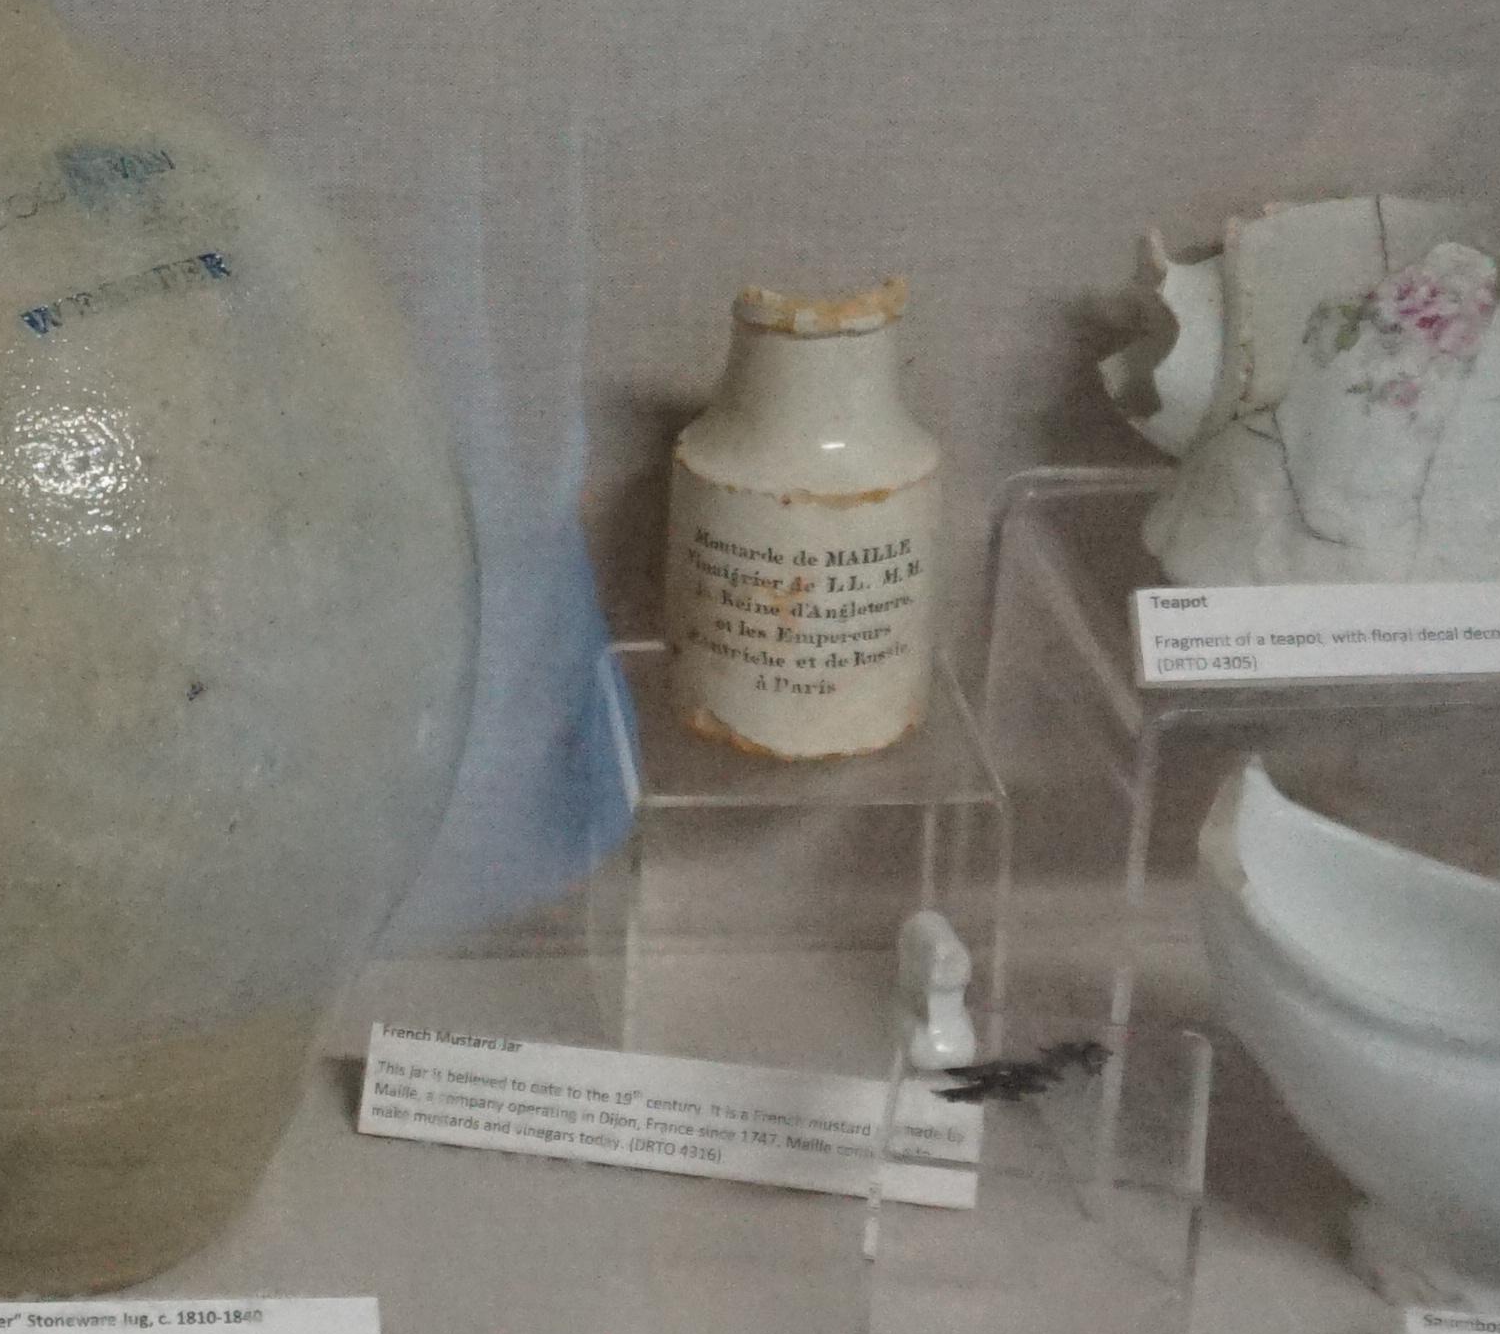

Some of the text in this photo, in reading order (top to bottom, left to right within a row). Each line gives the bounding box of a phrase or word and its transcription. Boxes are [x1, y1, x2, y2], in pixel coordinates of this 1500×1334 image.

[793, 550, 818, 567] de
[825, 538, 912, 568] MAILLE
[774, 676, 837, 695] Paris
